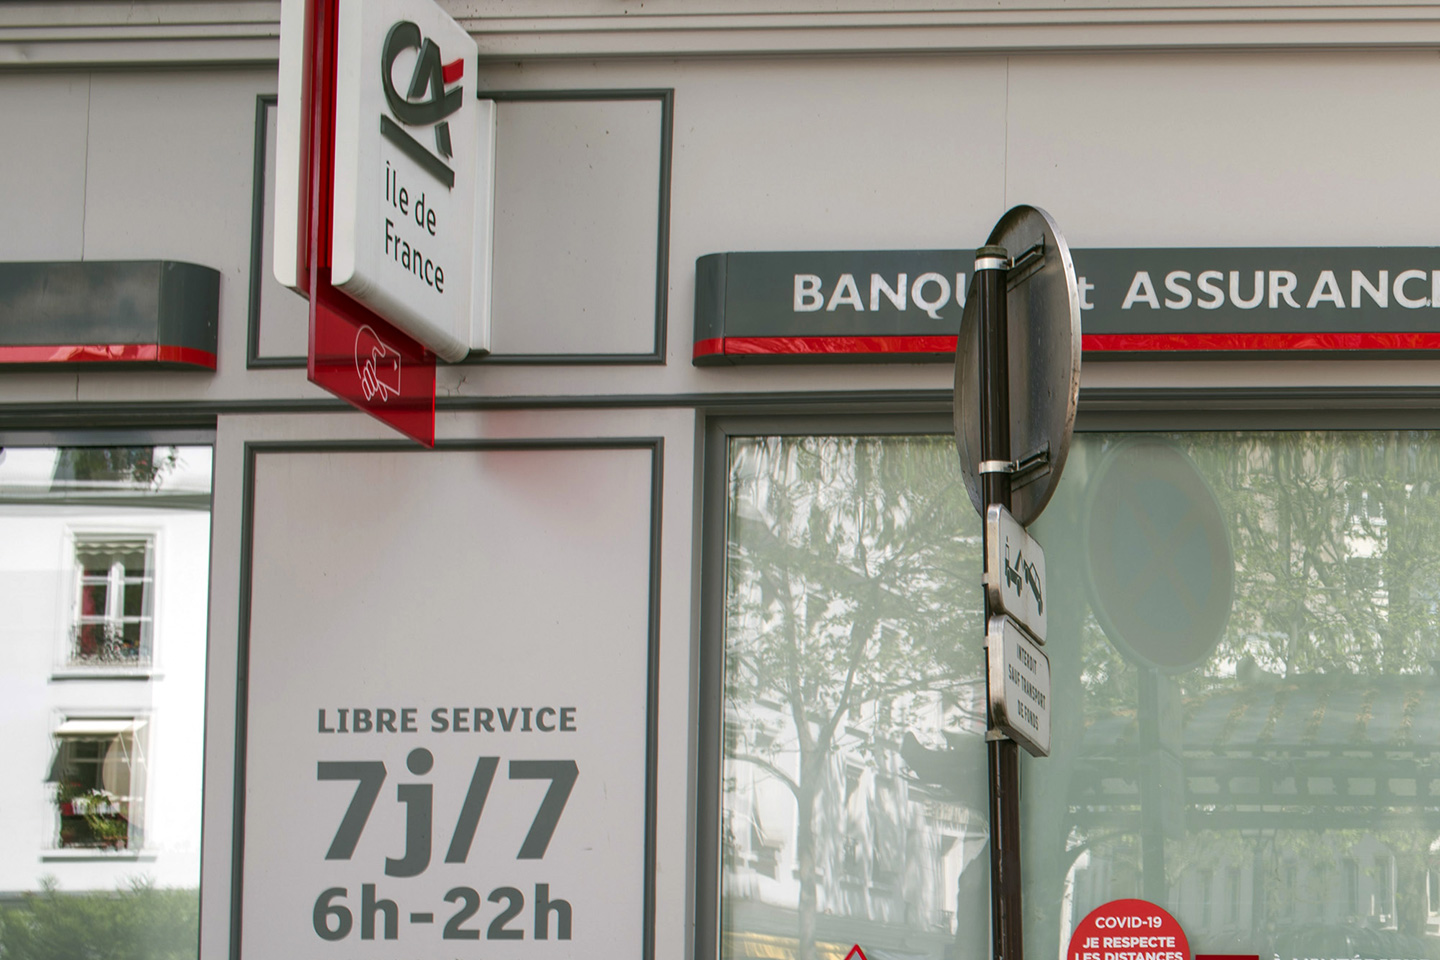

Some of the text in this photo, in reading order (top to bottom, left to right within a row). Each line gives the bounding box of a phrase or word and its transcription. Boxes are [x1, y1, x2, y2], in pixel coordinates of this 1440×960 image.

[415, 192, 437, 237] de
[385, 217, 444, 294] France
[793, 272, 966, 319] BANQ
[1016, 643, 1037, 675] INTERDIT
[1008, 663, 1046, 711] SAUF TRANSPORT
[318, 707, 577, 733] LIBRE SERVICE
[1017, 699, 1039, 731] DE FONDS
[317, 747, 580, 878] 7j/7
[312, 883, 573, 942] 6h-22h
[1095, 916, 1163, 929] COVID-19
[1082, 936, 1176, 949] JE RESPECTE
